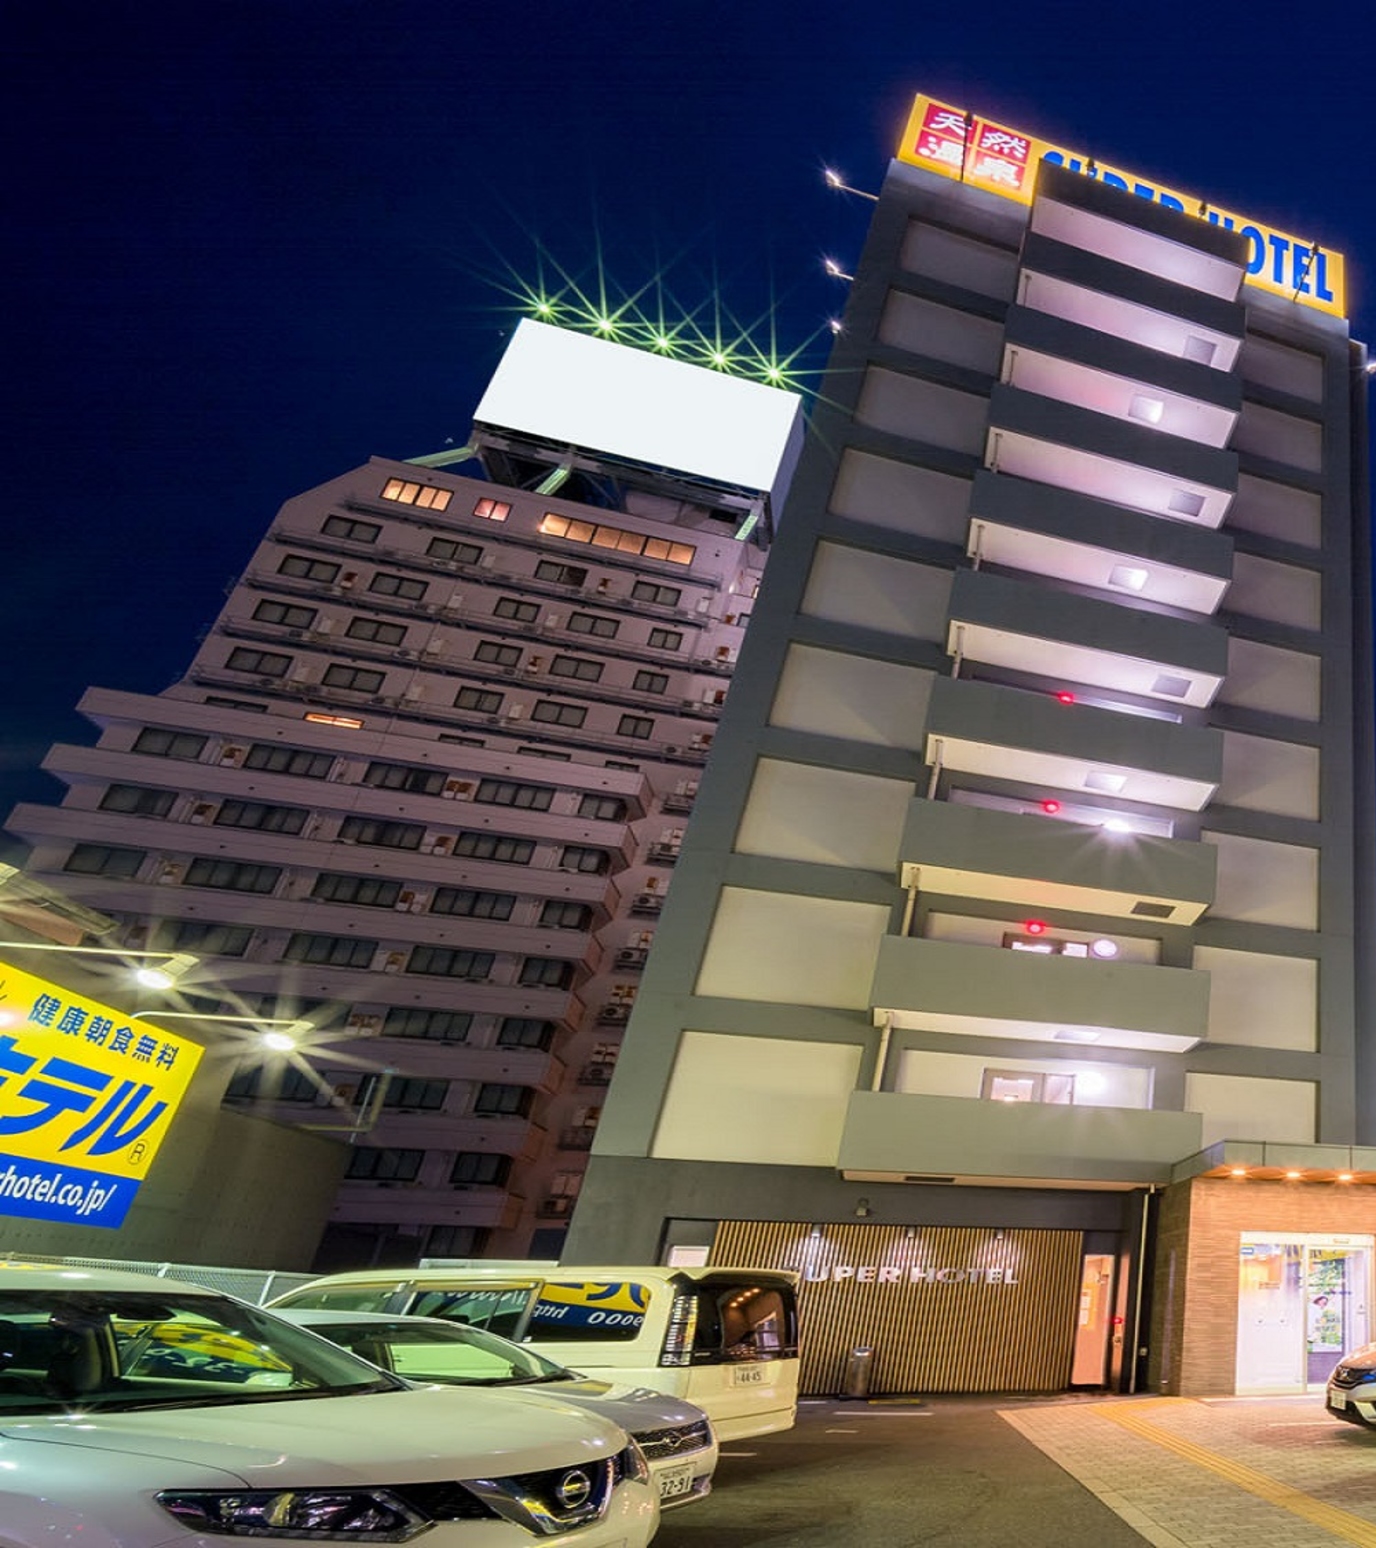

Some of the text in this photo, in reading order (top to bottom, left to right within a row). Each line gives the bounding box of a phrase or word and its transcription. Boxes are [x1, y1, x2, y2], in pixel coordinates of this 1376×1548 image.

[1208, 211, 1333, 303] OTEL
[27, 994, 179, 1071] 健康朝食無料
[783, 1264, 1019, 1285] UPER HOTEL
